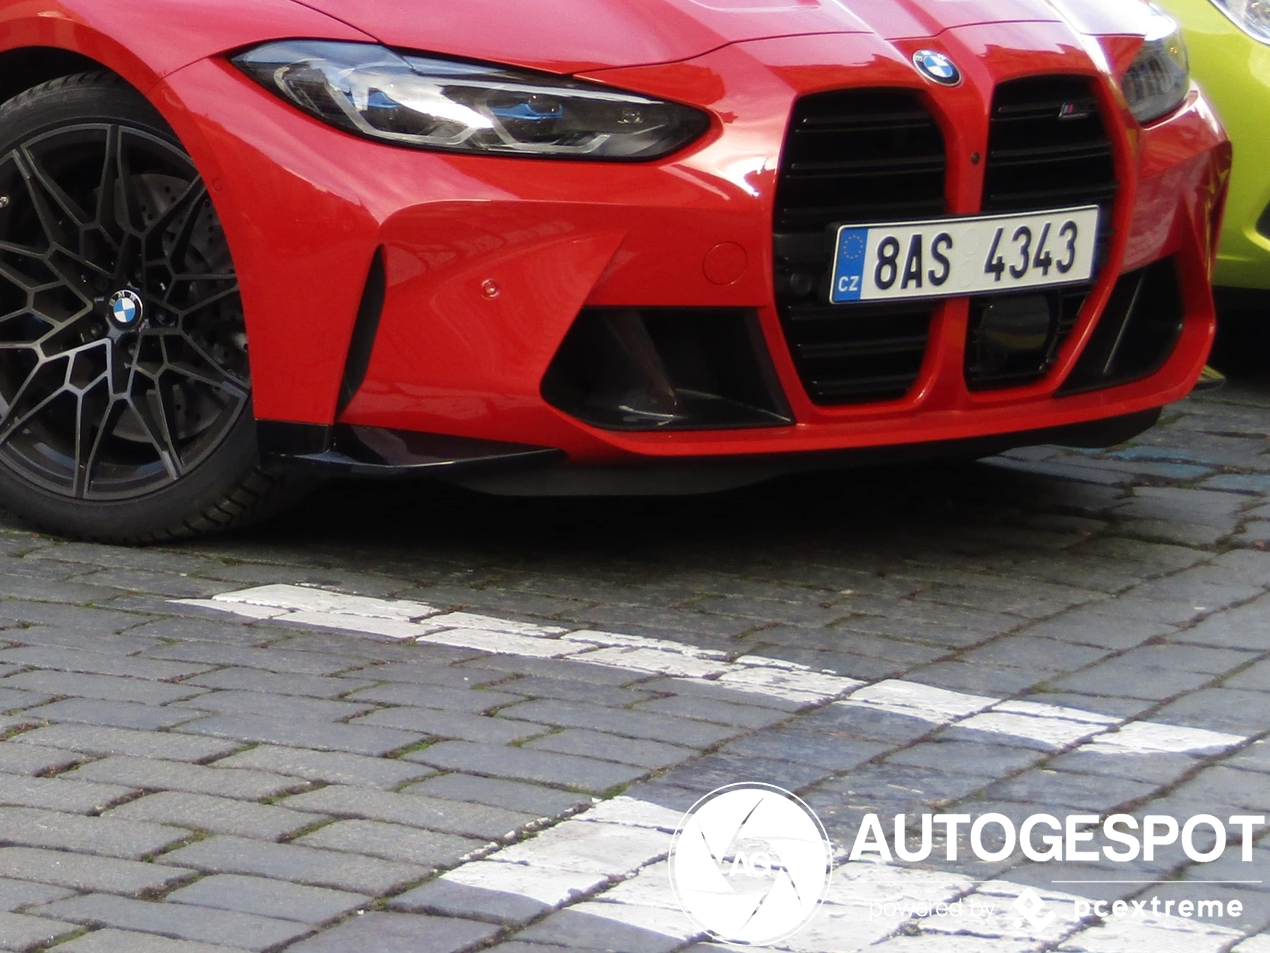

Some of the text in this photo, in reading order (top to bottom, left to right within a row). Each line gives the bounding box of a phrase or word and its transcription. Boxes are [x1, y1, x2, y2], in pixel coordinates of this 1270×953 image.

[874, 220, 1078, 290] 8AS 4343
[838, 276, 858, 292] CZ
